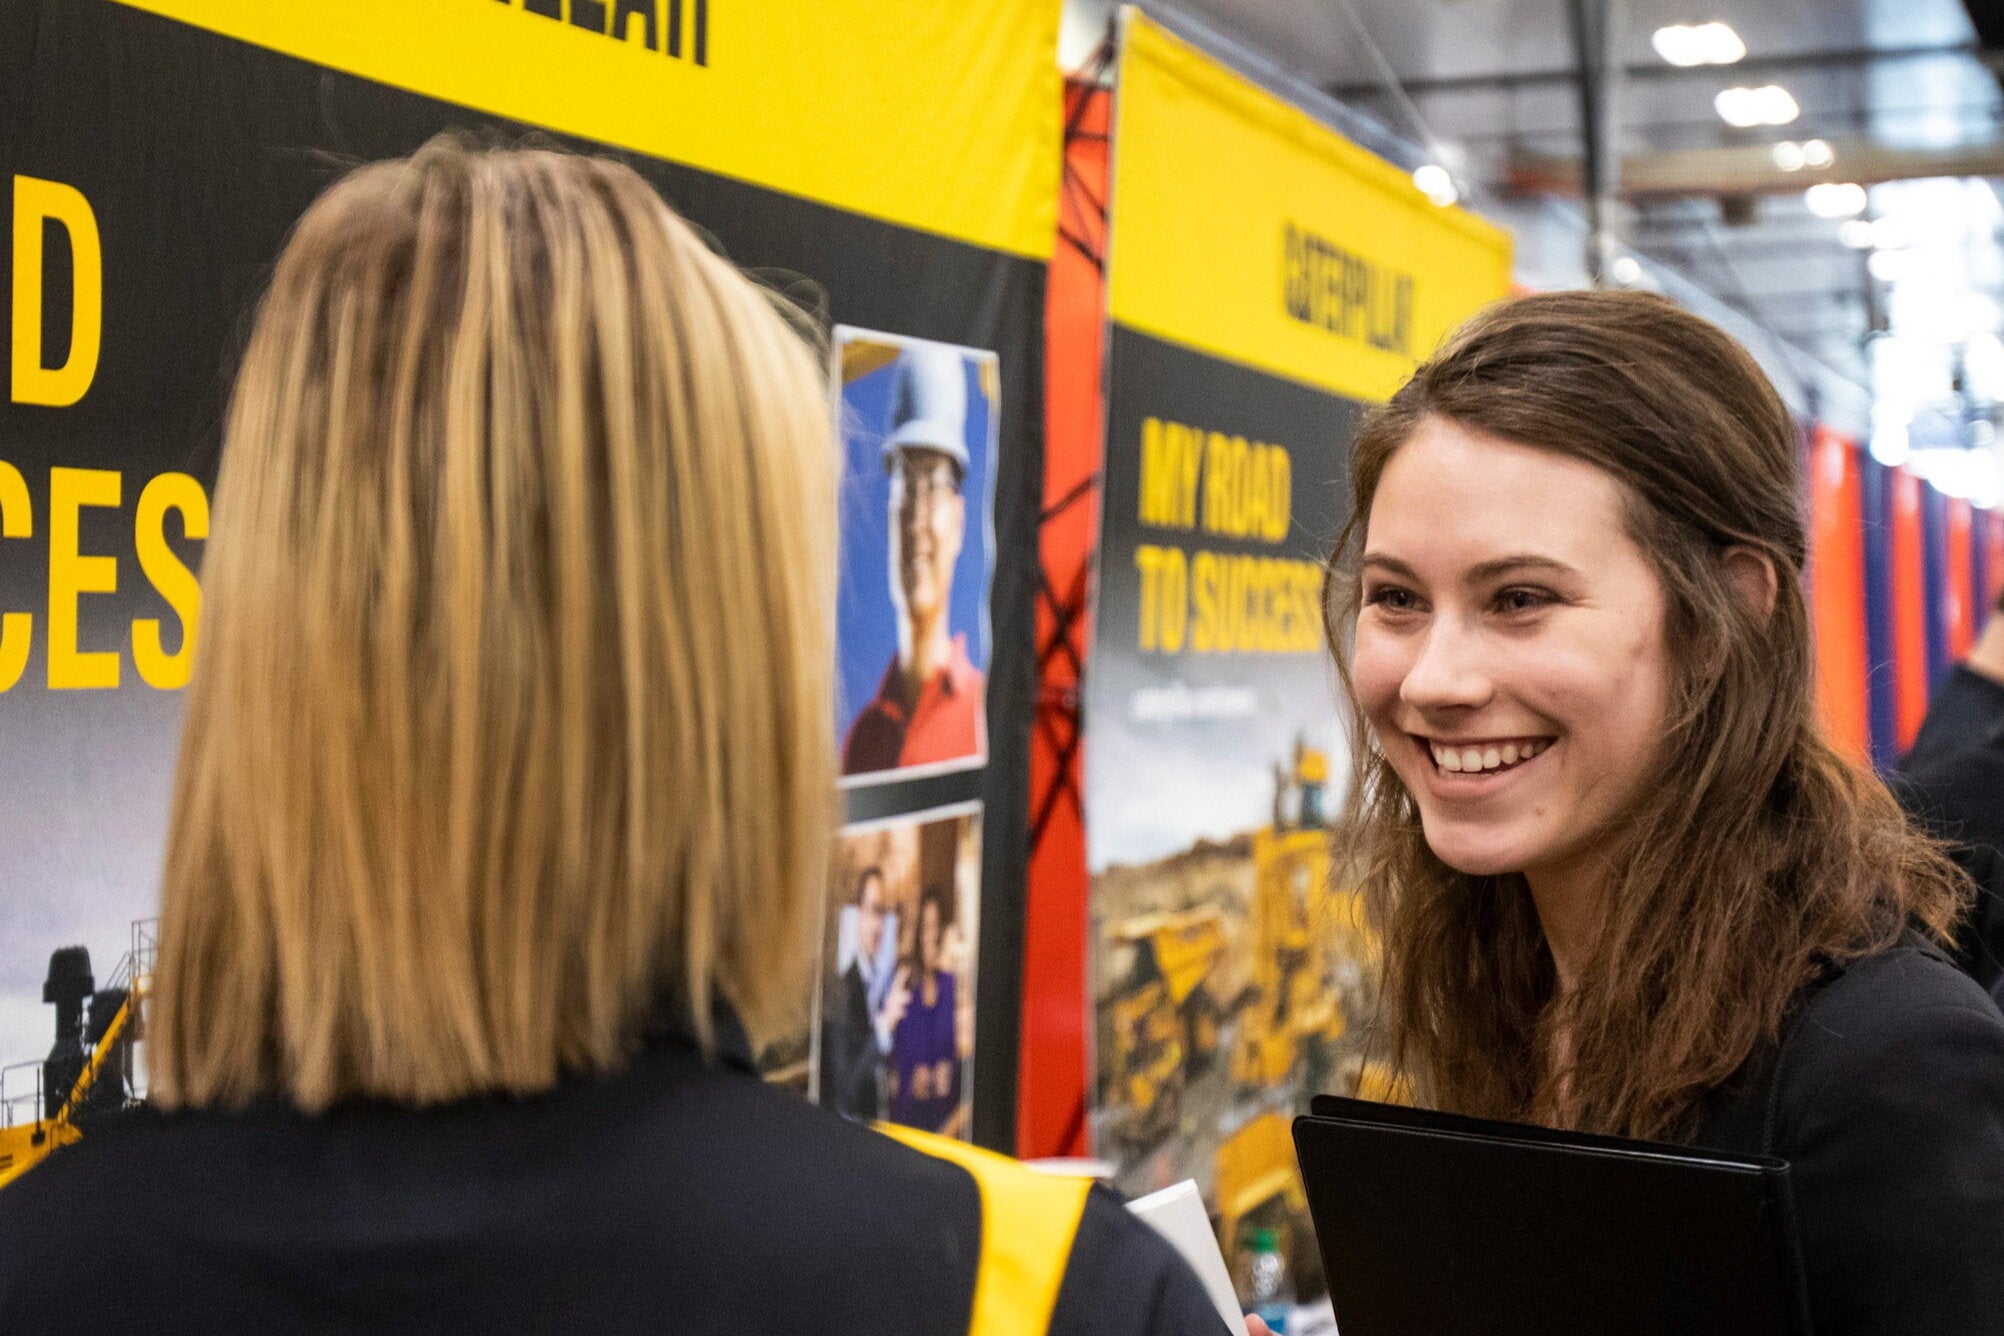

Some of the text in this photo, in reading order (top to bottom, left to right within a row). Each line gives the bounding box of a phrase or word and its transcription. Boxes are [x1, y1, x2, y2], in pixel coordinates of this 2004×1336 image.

[1140, 416, 1291, 543] MY ROAD
[1136, 545, 1188, 653] TO
